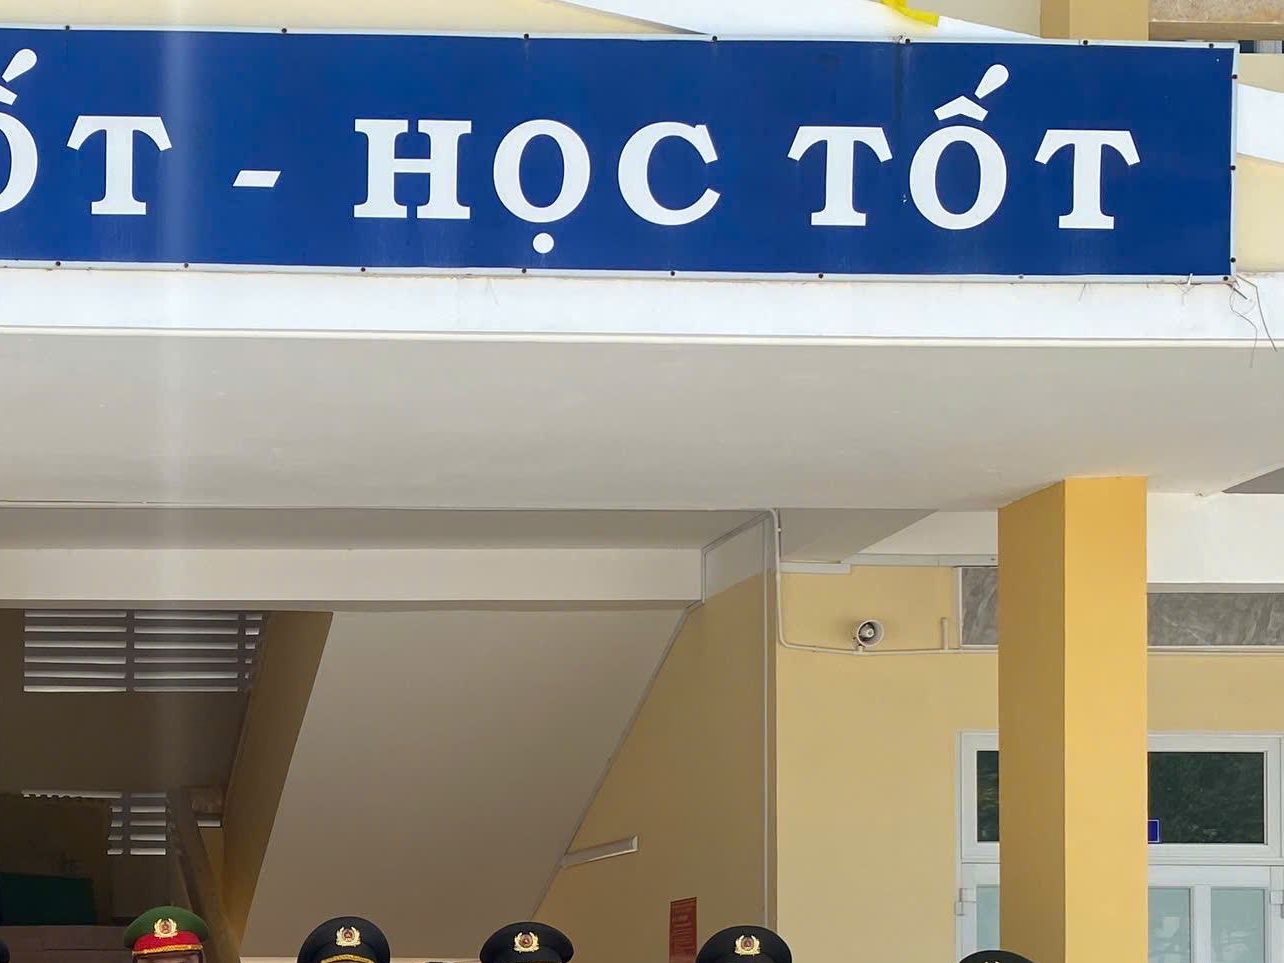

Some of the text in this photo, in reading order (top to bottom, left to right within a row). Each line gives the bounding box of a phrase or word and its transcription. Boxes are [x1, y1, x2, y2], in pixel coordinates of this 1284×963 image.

[233, 170, 280, 187] -
[354, 119, 720, 253] HỌC
[788, 65, 1140, 229] TỐT
